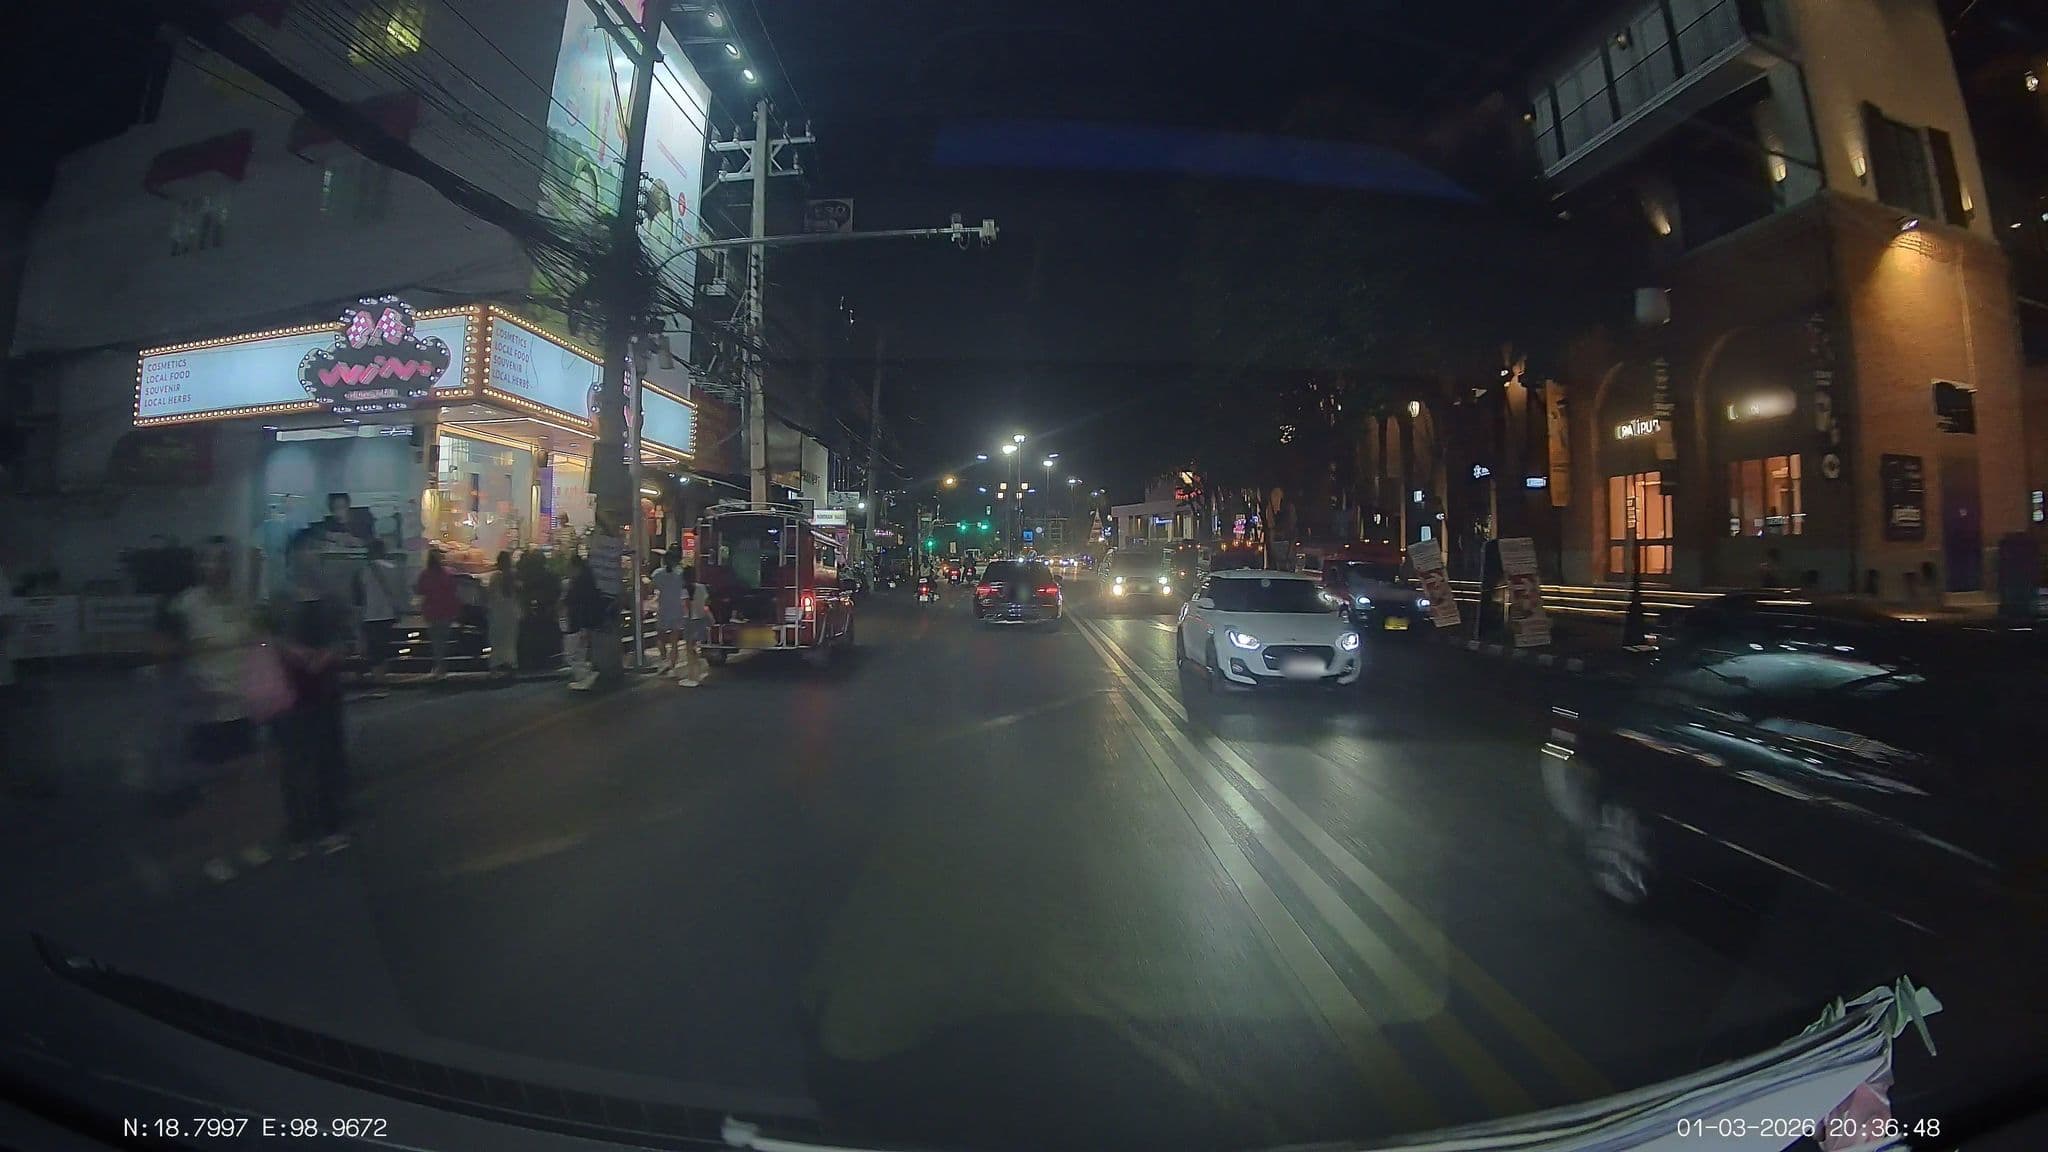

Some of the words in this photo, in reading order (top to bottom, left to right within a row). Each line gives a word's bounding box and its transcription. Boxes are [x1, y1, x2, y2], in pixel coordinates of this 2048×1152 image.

[496, 328, 527, 349] COSMETICS
[495, 342, 513, 356] LOCAL
[515, 349, 530, 363] FOOD
[147, 359, 187, 372] COSMETICS
[493, 354, 523, 373] SOUVENIR
[146, 373, 168, 384] LOCAL
[169, 370, 190, 381] FOOD
[493, 368, 511, 384] LOCAL
[512, 375, 530, 390] HERBS
[145, 383, 181, 396] SOUVENIR
[144, 397, 167, 408] LOCAL
[168, 394, 192, 405] HERBS
